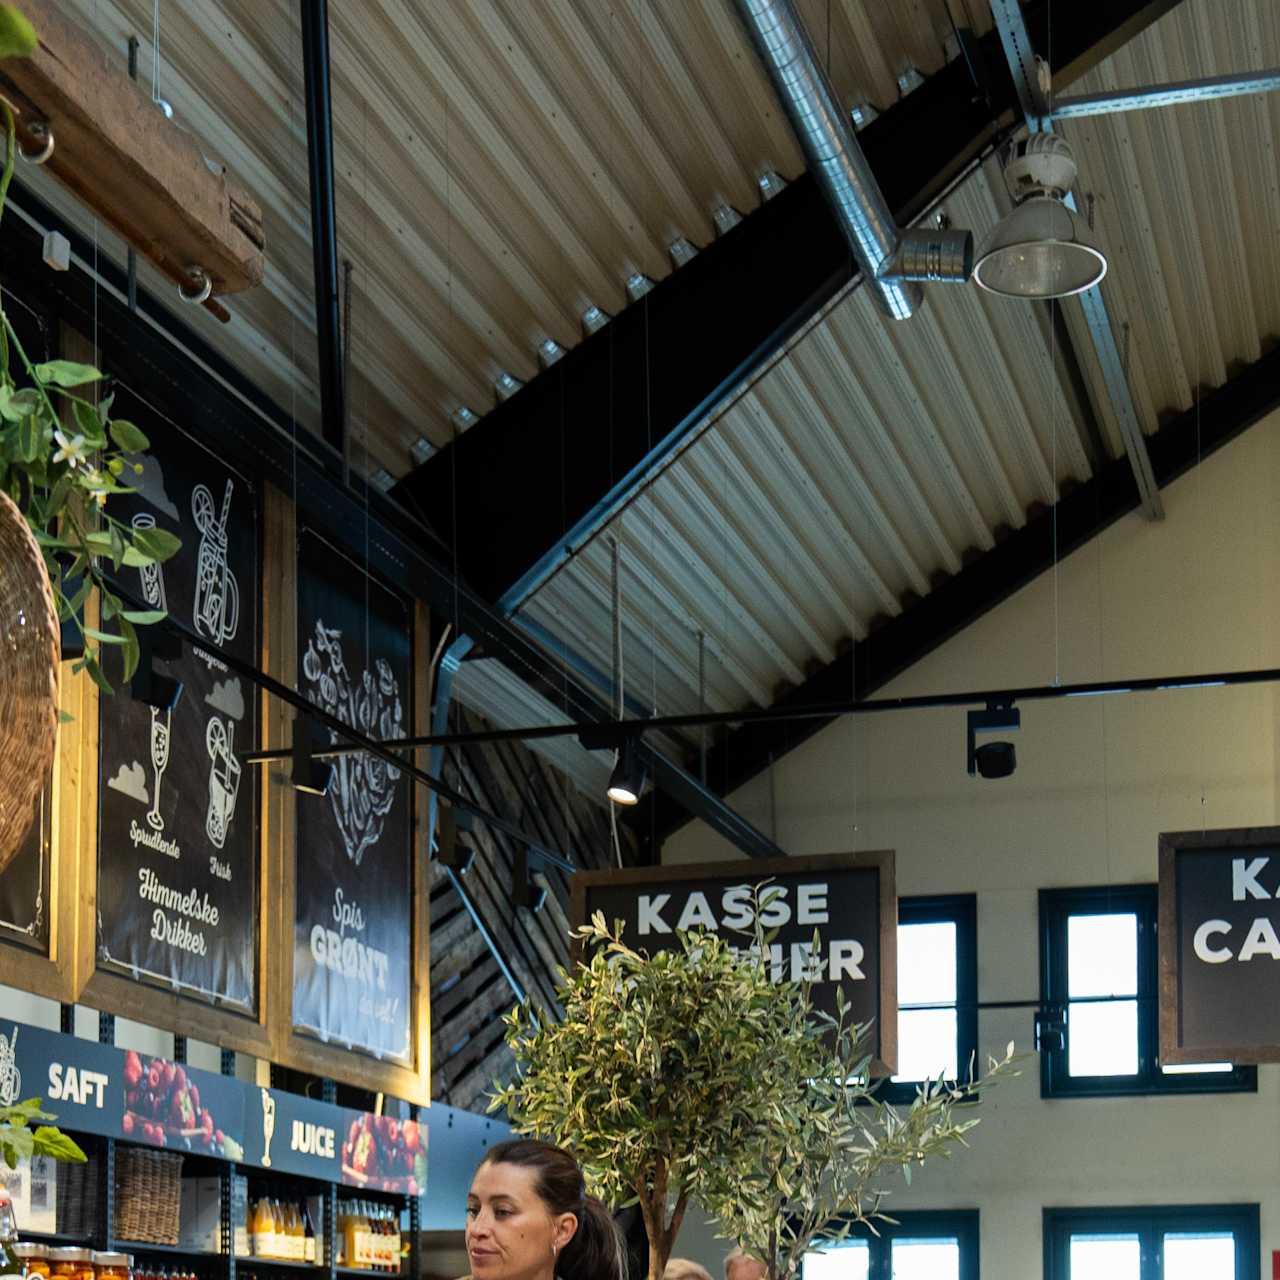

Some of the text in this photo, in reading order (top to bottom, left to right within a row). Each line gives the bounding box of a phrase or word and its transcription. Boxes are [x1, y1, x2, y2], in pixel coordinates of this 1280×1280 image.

[129, 820, 181, 859] Sprudlende
[138, 867, 220, 927] Himmelske
[332, 887, 366, 938] Spis
[637, 882, 829, 936] KASSE
[150, 910, 208, 958] Drikker
[310, 923, 389, 992] GRØNT
[47, 1062, 110, 1109] SAFT
[290, 1119, 336, 1160] JUICE
